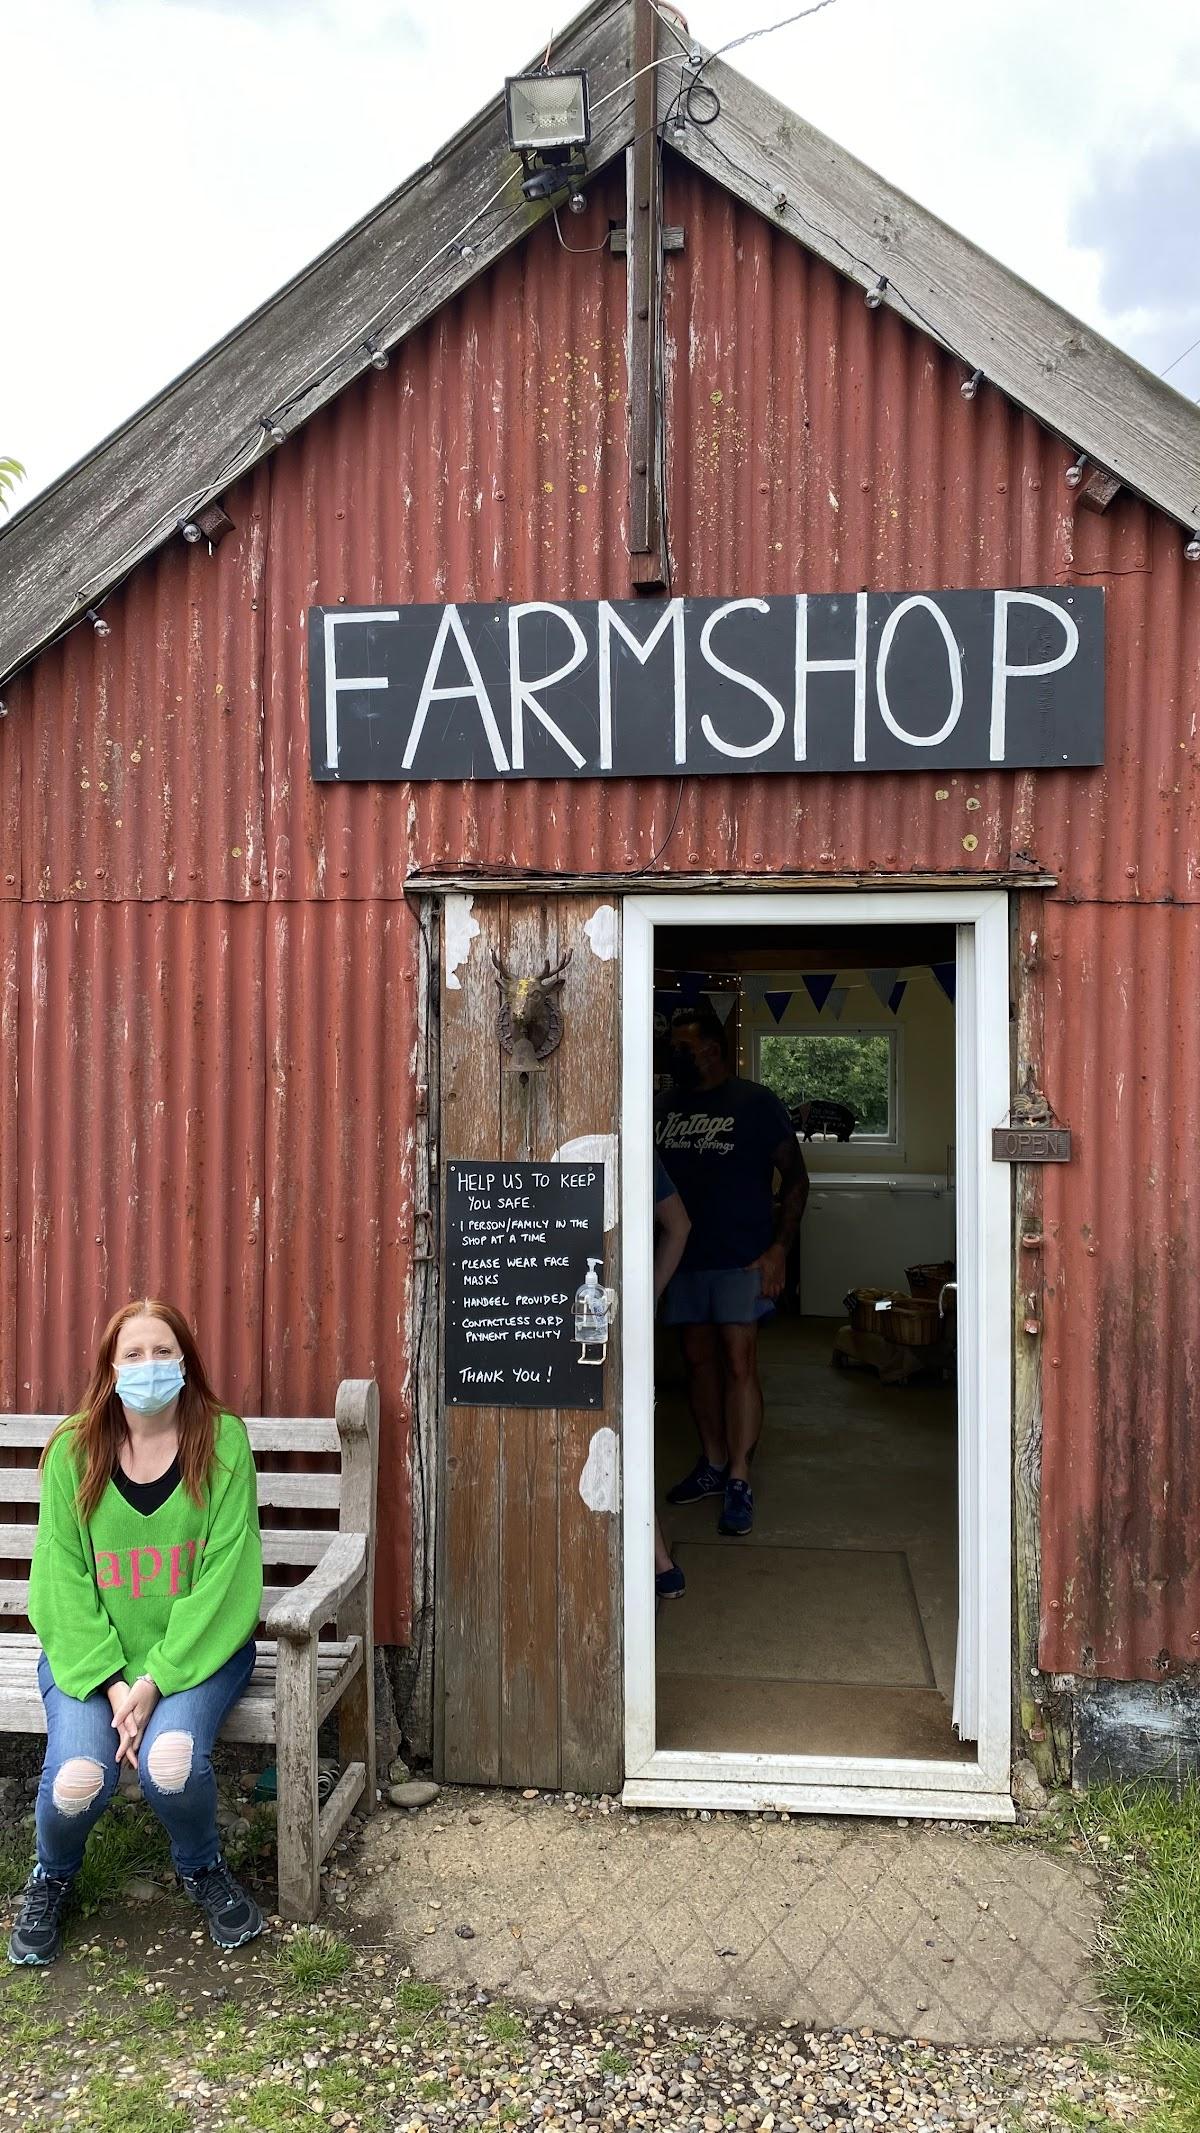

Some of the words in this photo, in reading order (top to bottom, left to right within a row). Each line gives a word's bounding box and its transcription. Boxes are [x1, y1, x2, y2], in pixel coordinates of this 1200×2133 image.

[655, 1112, 735, 1145] Vintage
[665, 1136, 691, 1149] Palm
[693, 1137, 735, 1155] Springs
[1006, 1134, 1059, 1155] OPEN
[457, 1171, 496, 1193] HELP
[502, 1173, 523, 1190] US
[531, 1172, 550, 1188] TO
[560, 1172, 596, 1189] KEEP
[496, 1196, 536, 1210] SAFE.
[468, 1217, 550, 1233] PERSON/FAMILY
[555, 1219, 567, 1229] IN
[569, 1218, 589, 1229] THE
[461, 1235, 488, 1247] SHOP
[490, 1234, 505, 1245] AT
[508, 1233, 517, 1244] A
[520, 1232, 547, 1244] TIME
[461, 1257, 501, 1271] PLEASE
[506, 1256, 538, 1269] WEAR
[543, 1256, 570, 1267] FACE
[463, 1273, 499, 1286] MASKS
[463, 1296, 510, 1309] HANDGEL
[515, 1293, 569, 1306] PROVIDED
[461, 1316, 531, 1329] CONTACTLESS
[534, 1315, 564, 1327] CARD
[465, 1330, 510, 1343] PAYMENT
[514, 1329, 561, 1341] FACILITY
[458, 1366, 505, 1384] THANK
